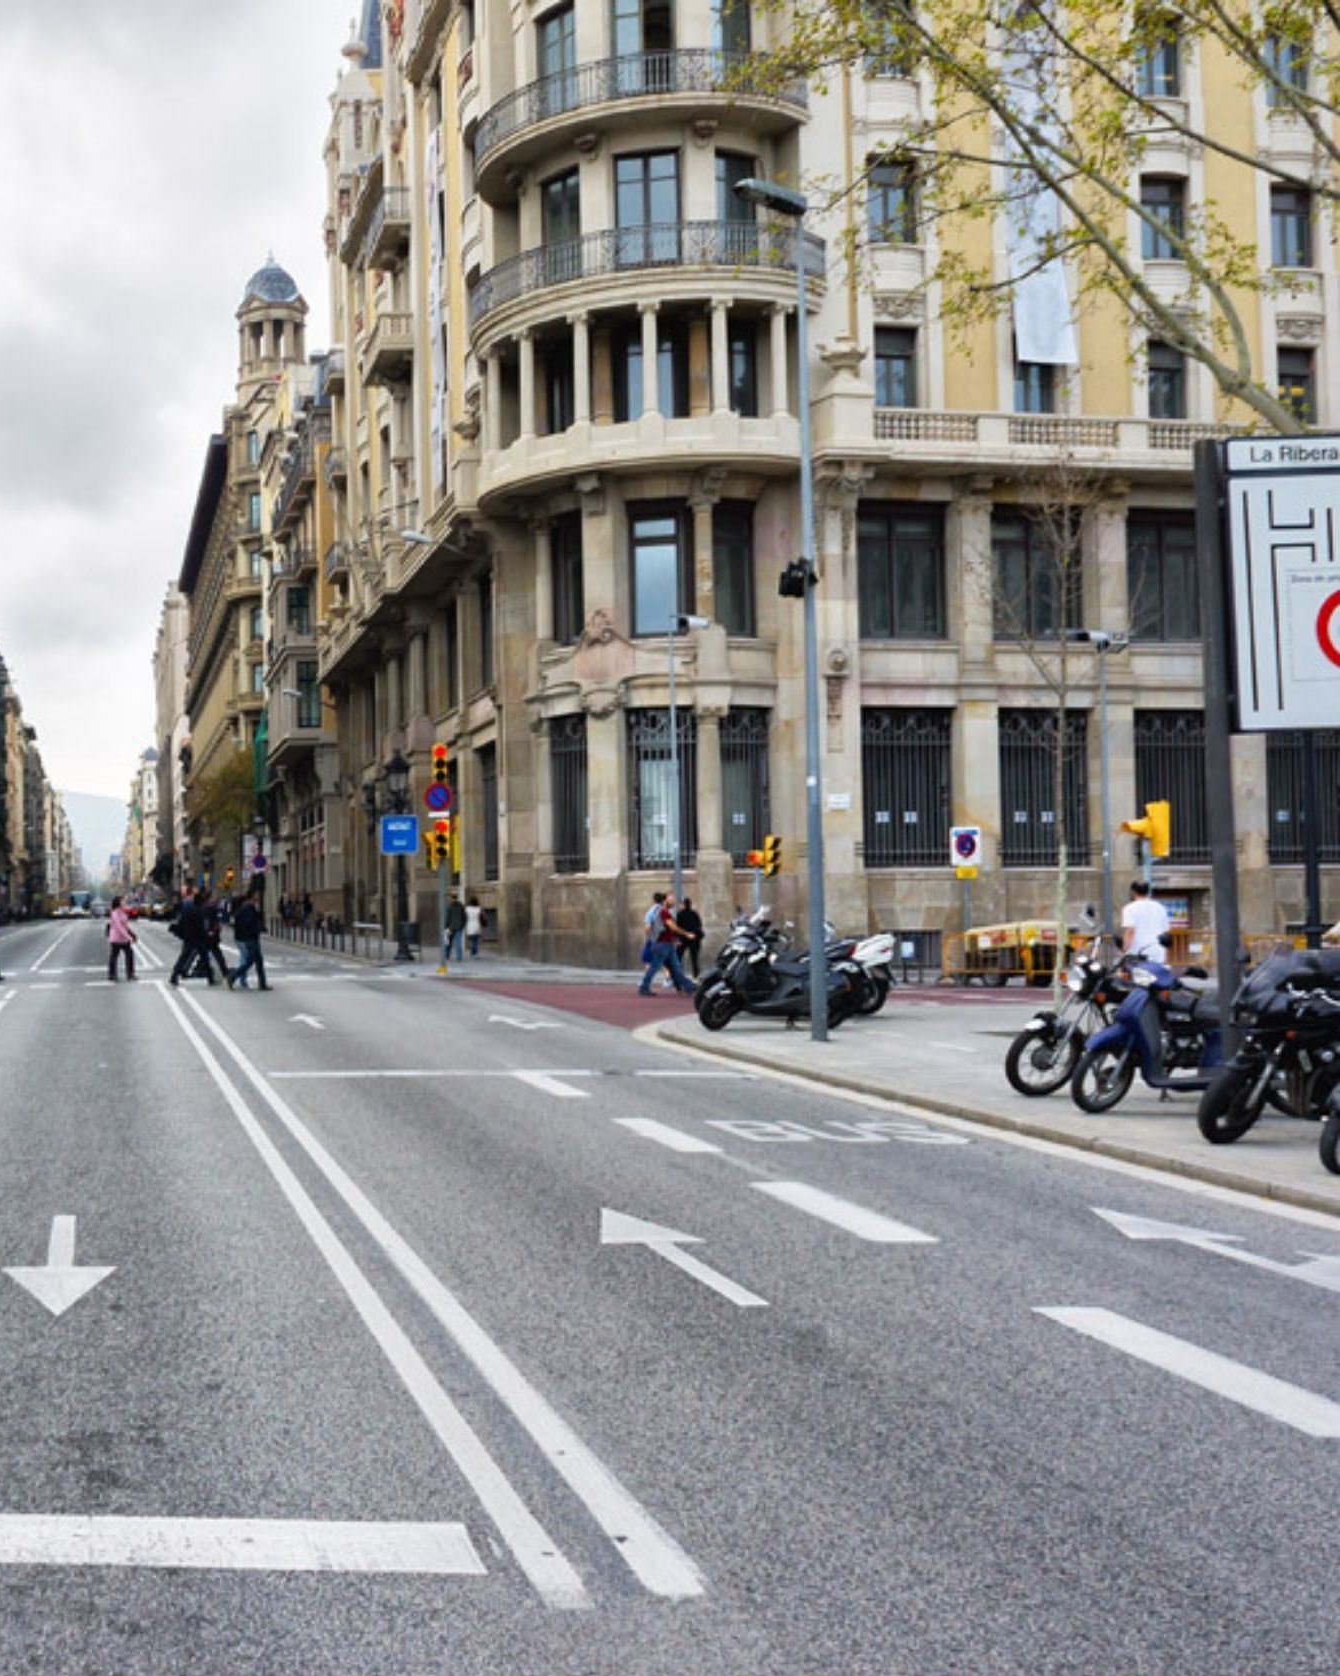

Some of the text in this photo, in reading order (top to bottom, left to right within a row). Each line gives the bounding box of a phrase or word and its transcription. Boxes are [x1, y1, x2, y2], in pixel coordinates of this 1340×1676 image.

[1250, 444, 1339, 463] La Ribera
[704, 1119, 971, 1145] BUS
